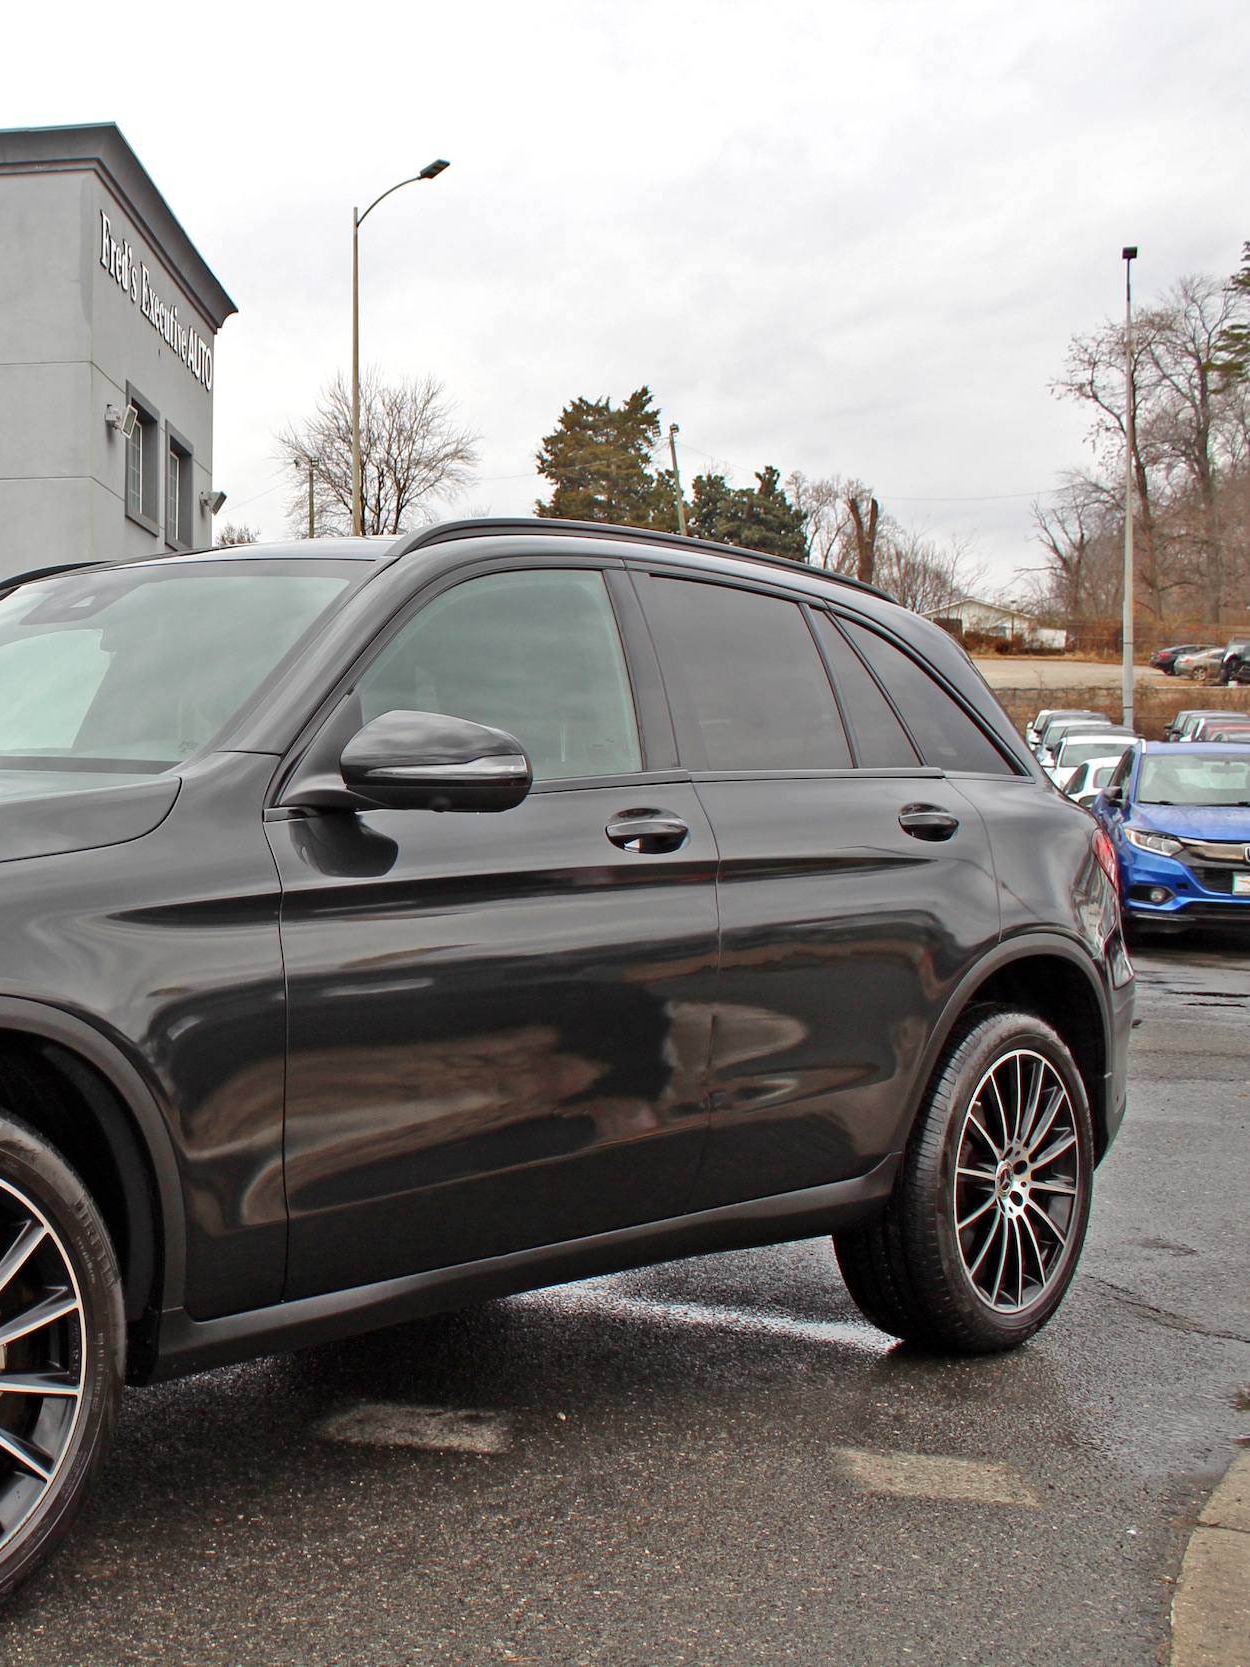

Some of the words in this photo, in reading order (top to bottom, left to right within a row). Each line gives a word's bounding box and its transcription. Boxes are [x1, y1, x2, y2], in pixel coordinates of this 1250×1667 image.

[100, 209, 138, 303] Fred's
[140, 261, 187, 363] Executive
[187, 325, 213, 392] AUTO
